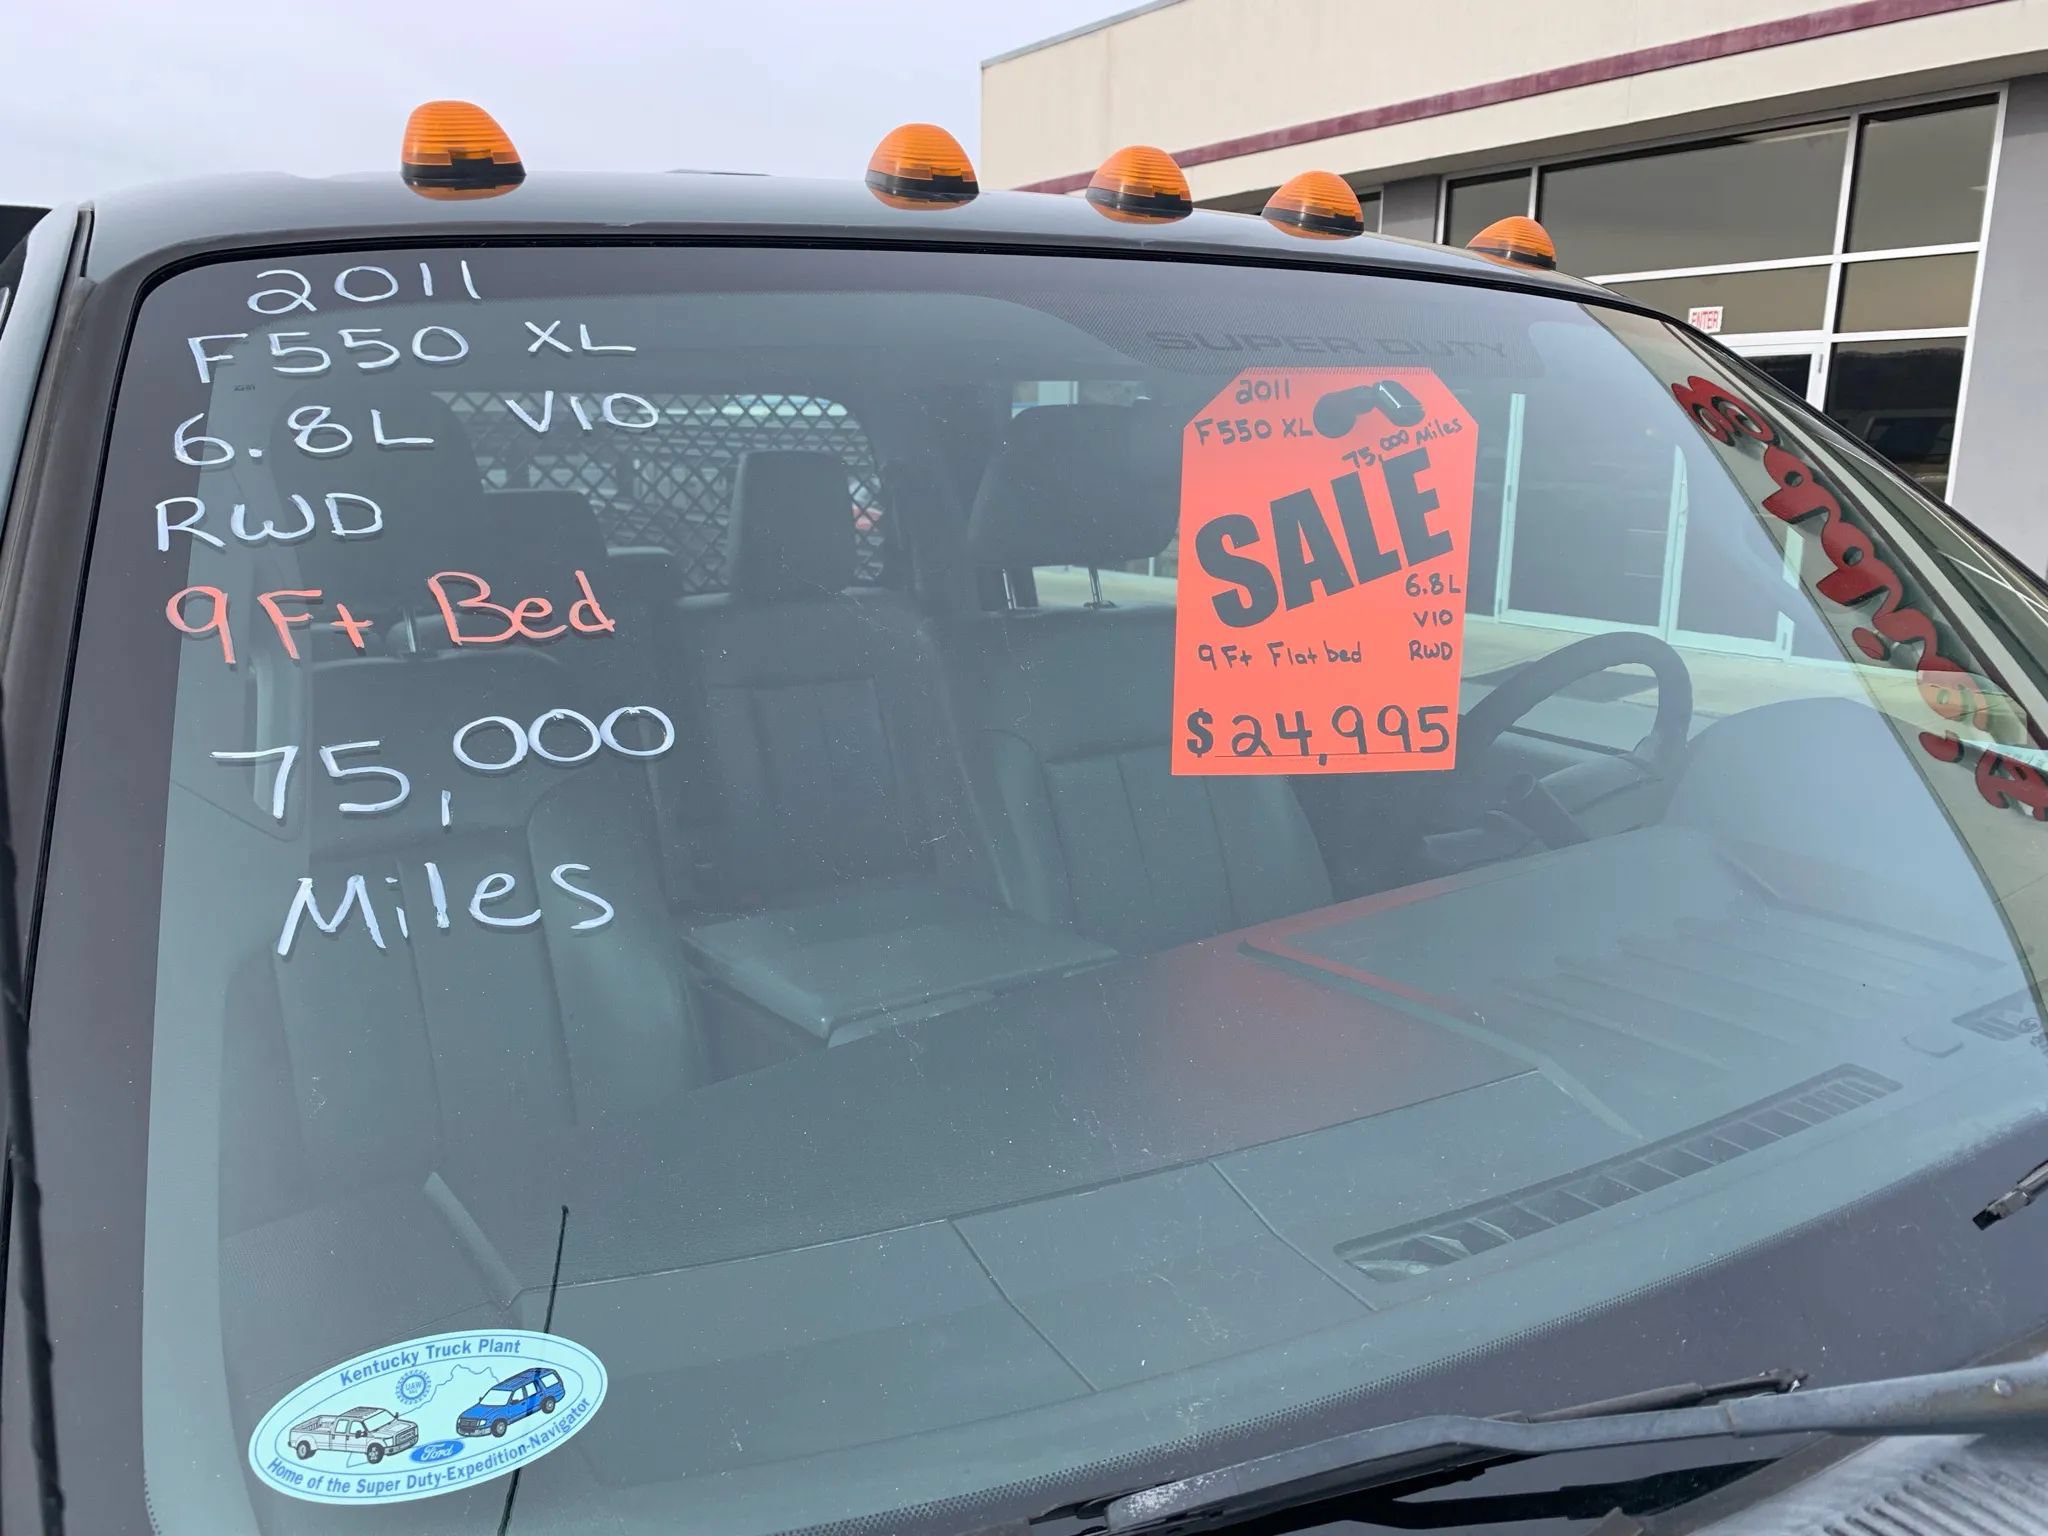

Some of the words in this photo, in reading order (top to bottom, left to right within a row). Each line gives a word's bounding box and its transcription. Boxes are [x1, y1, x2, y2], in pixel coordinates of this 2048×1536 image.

[248, 260, 481, 314] 2011
[188, 325, 469, 383] F550
[524, 320, 636, 353] XL
[1149, 332, 1366, 355] SUPER
[1376, 337, 1508, 357] DUTY
[1234, 378, 1291, 406] 2011
[173, 405, 435, 466] 6.8L
[506, 390, 659, 433] V10
[1193, 417, 1273, 446] F550
[1280, 417, 1314, 439] XL
[1341, 430, 1410, 470] 75,000
[1415, 418, 1463, 447] Miles
[156, 492, 383, 552] RWD
[1195, 447, 1454, 629] SALE
[1403, 572, 1462, 598] 6.8L
[166, 585, 237, 664] 9
[258, 588, 373, 660] Ft
[427, 569, 616, 646] Bed
[1412, 608, 1454, 628] V10
[1197, 643, 1218, 671] 9
[1408, 639, 1453, 662] RWD
[208, 704, 675, 827] 75,000
[277, 861, 615, 957] Miles
[339, 1349, 420, 1387] Kentucky
[425, 1339, 472, 1360] Truck
[477, 1338, 521, 1354] Plant
[420, 1442, 455, 1461] Ford
[266, 1457, 304, 1486] Home
[306, 1472, 324, 1491] of
[326, 1476, 352, 1494] the
[355, 1478, 401, 1496] Super
